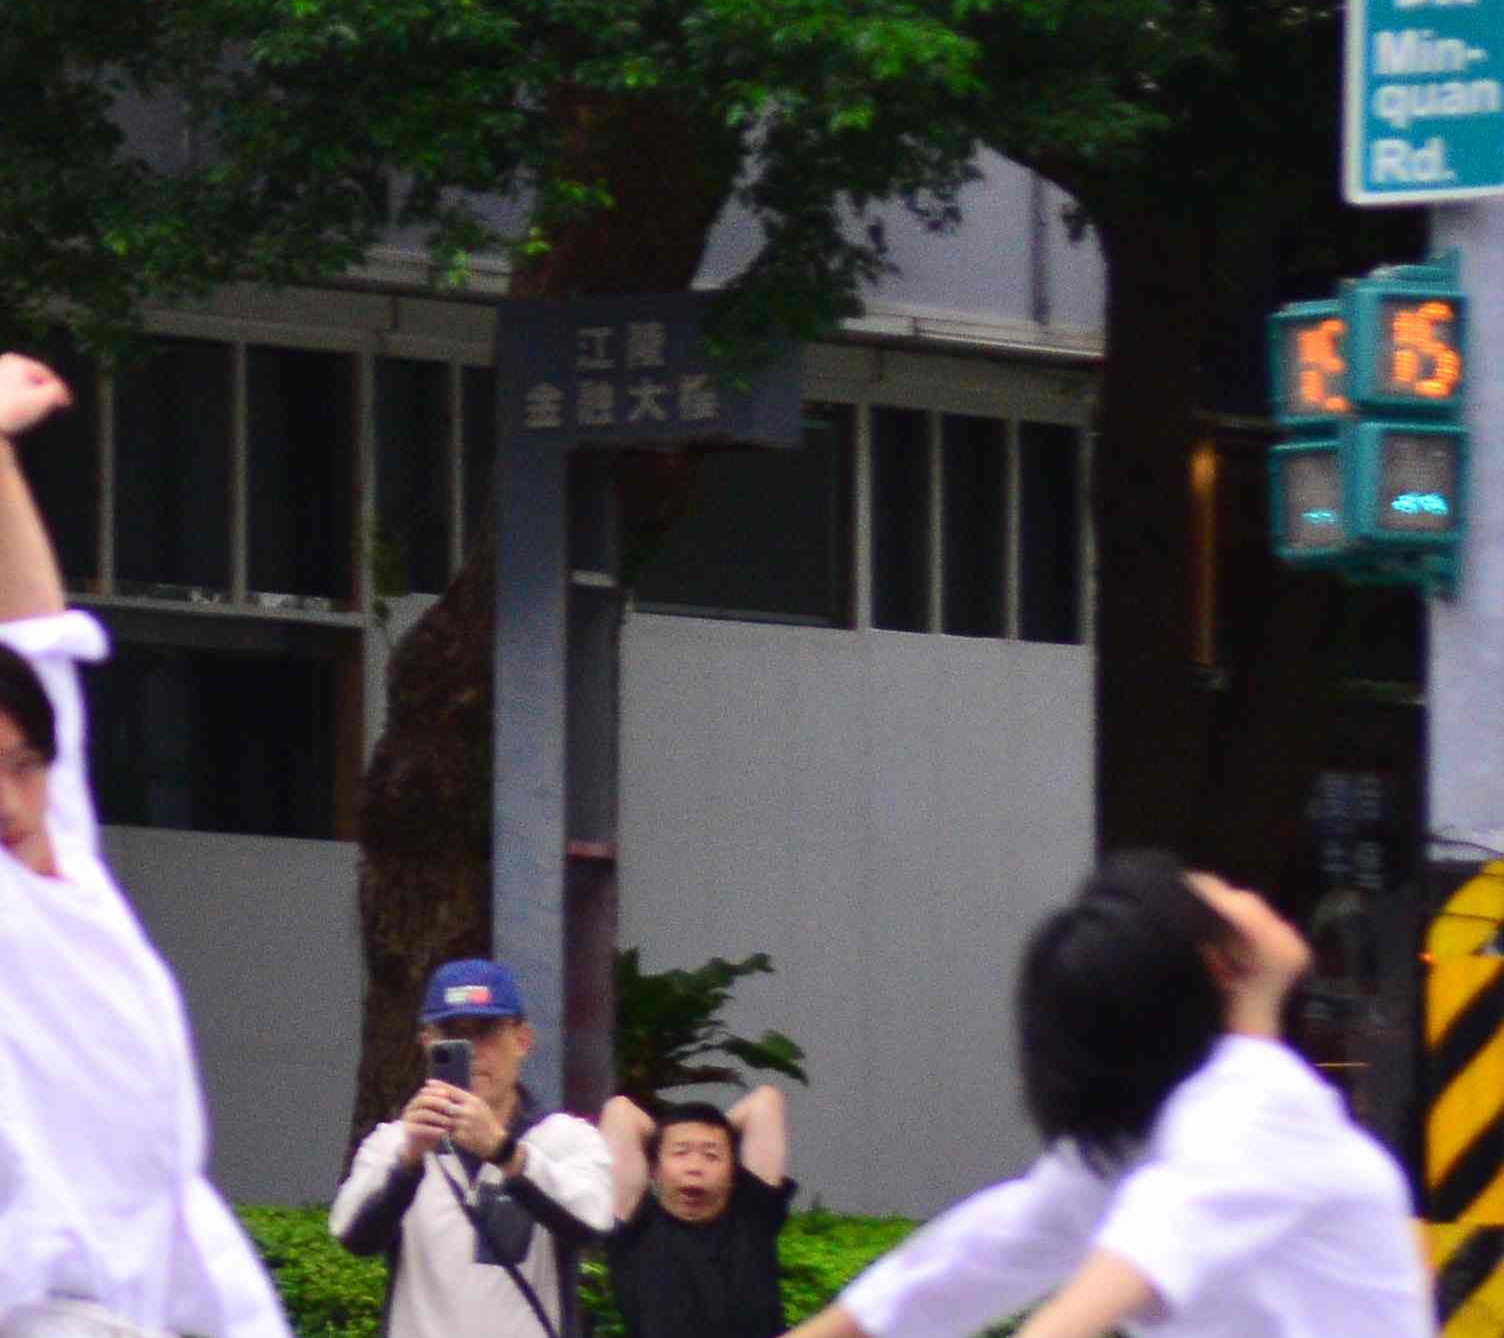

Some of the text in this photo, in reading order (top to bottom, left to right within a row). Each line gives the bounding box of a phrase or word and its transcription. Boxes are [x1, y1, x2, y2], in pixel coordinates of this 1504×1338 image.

[1373, 27, 1486, 75] Min-
[1374, 78, 1500, 128] quan
[1369, 138, 1457, 183] Rd.
